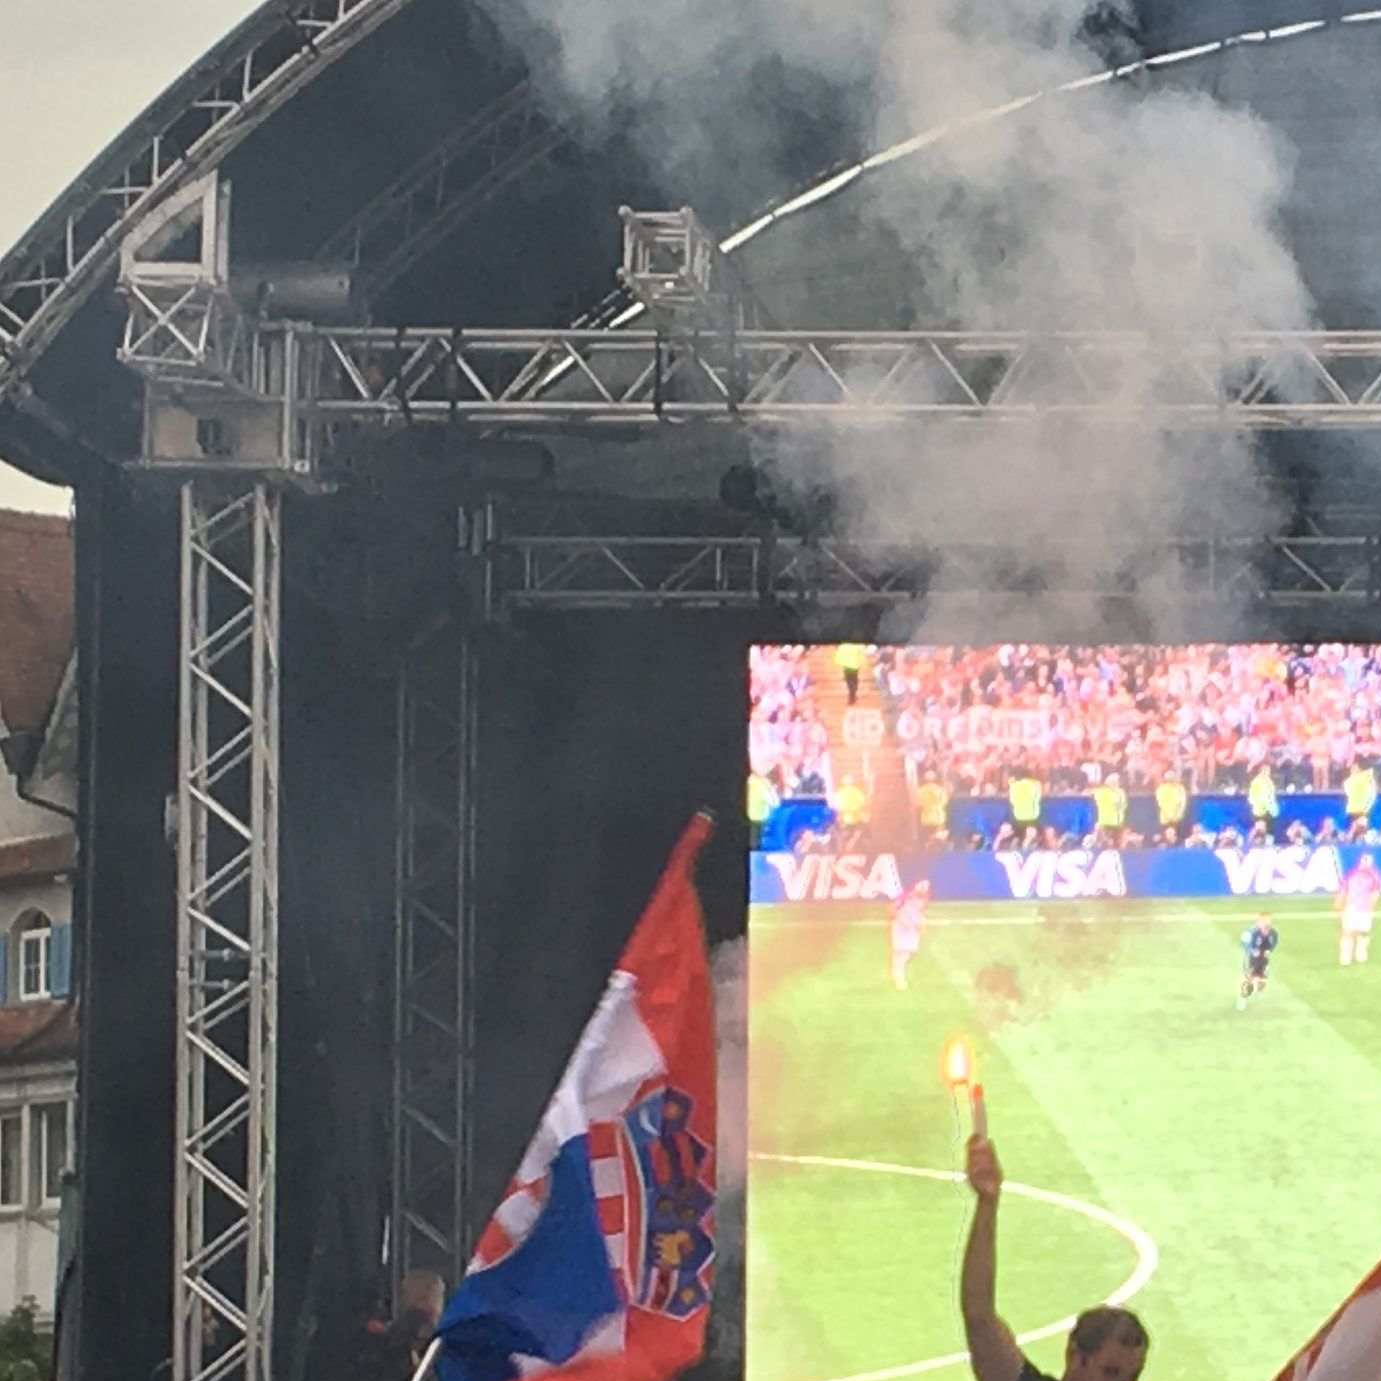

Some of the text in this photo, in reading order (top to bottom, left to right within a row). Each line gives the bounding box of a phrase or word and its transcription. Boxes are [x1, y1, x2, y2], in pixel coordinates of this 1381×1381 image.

[767, 852, 902, 901] VISA
[995, 849, 1126, 898] VISA
[1214, 845, 1343, 895] VISA
